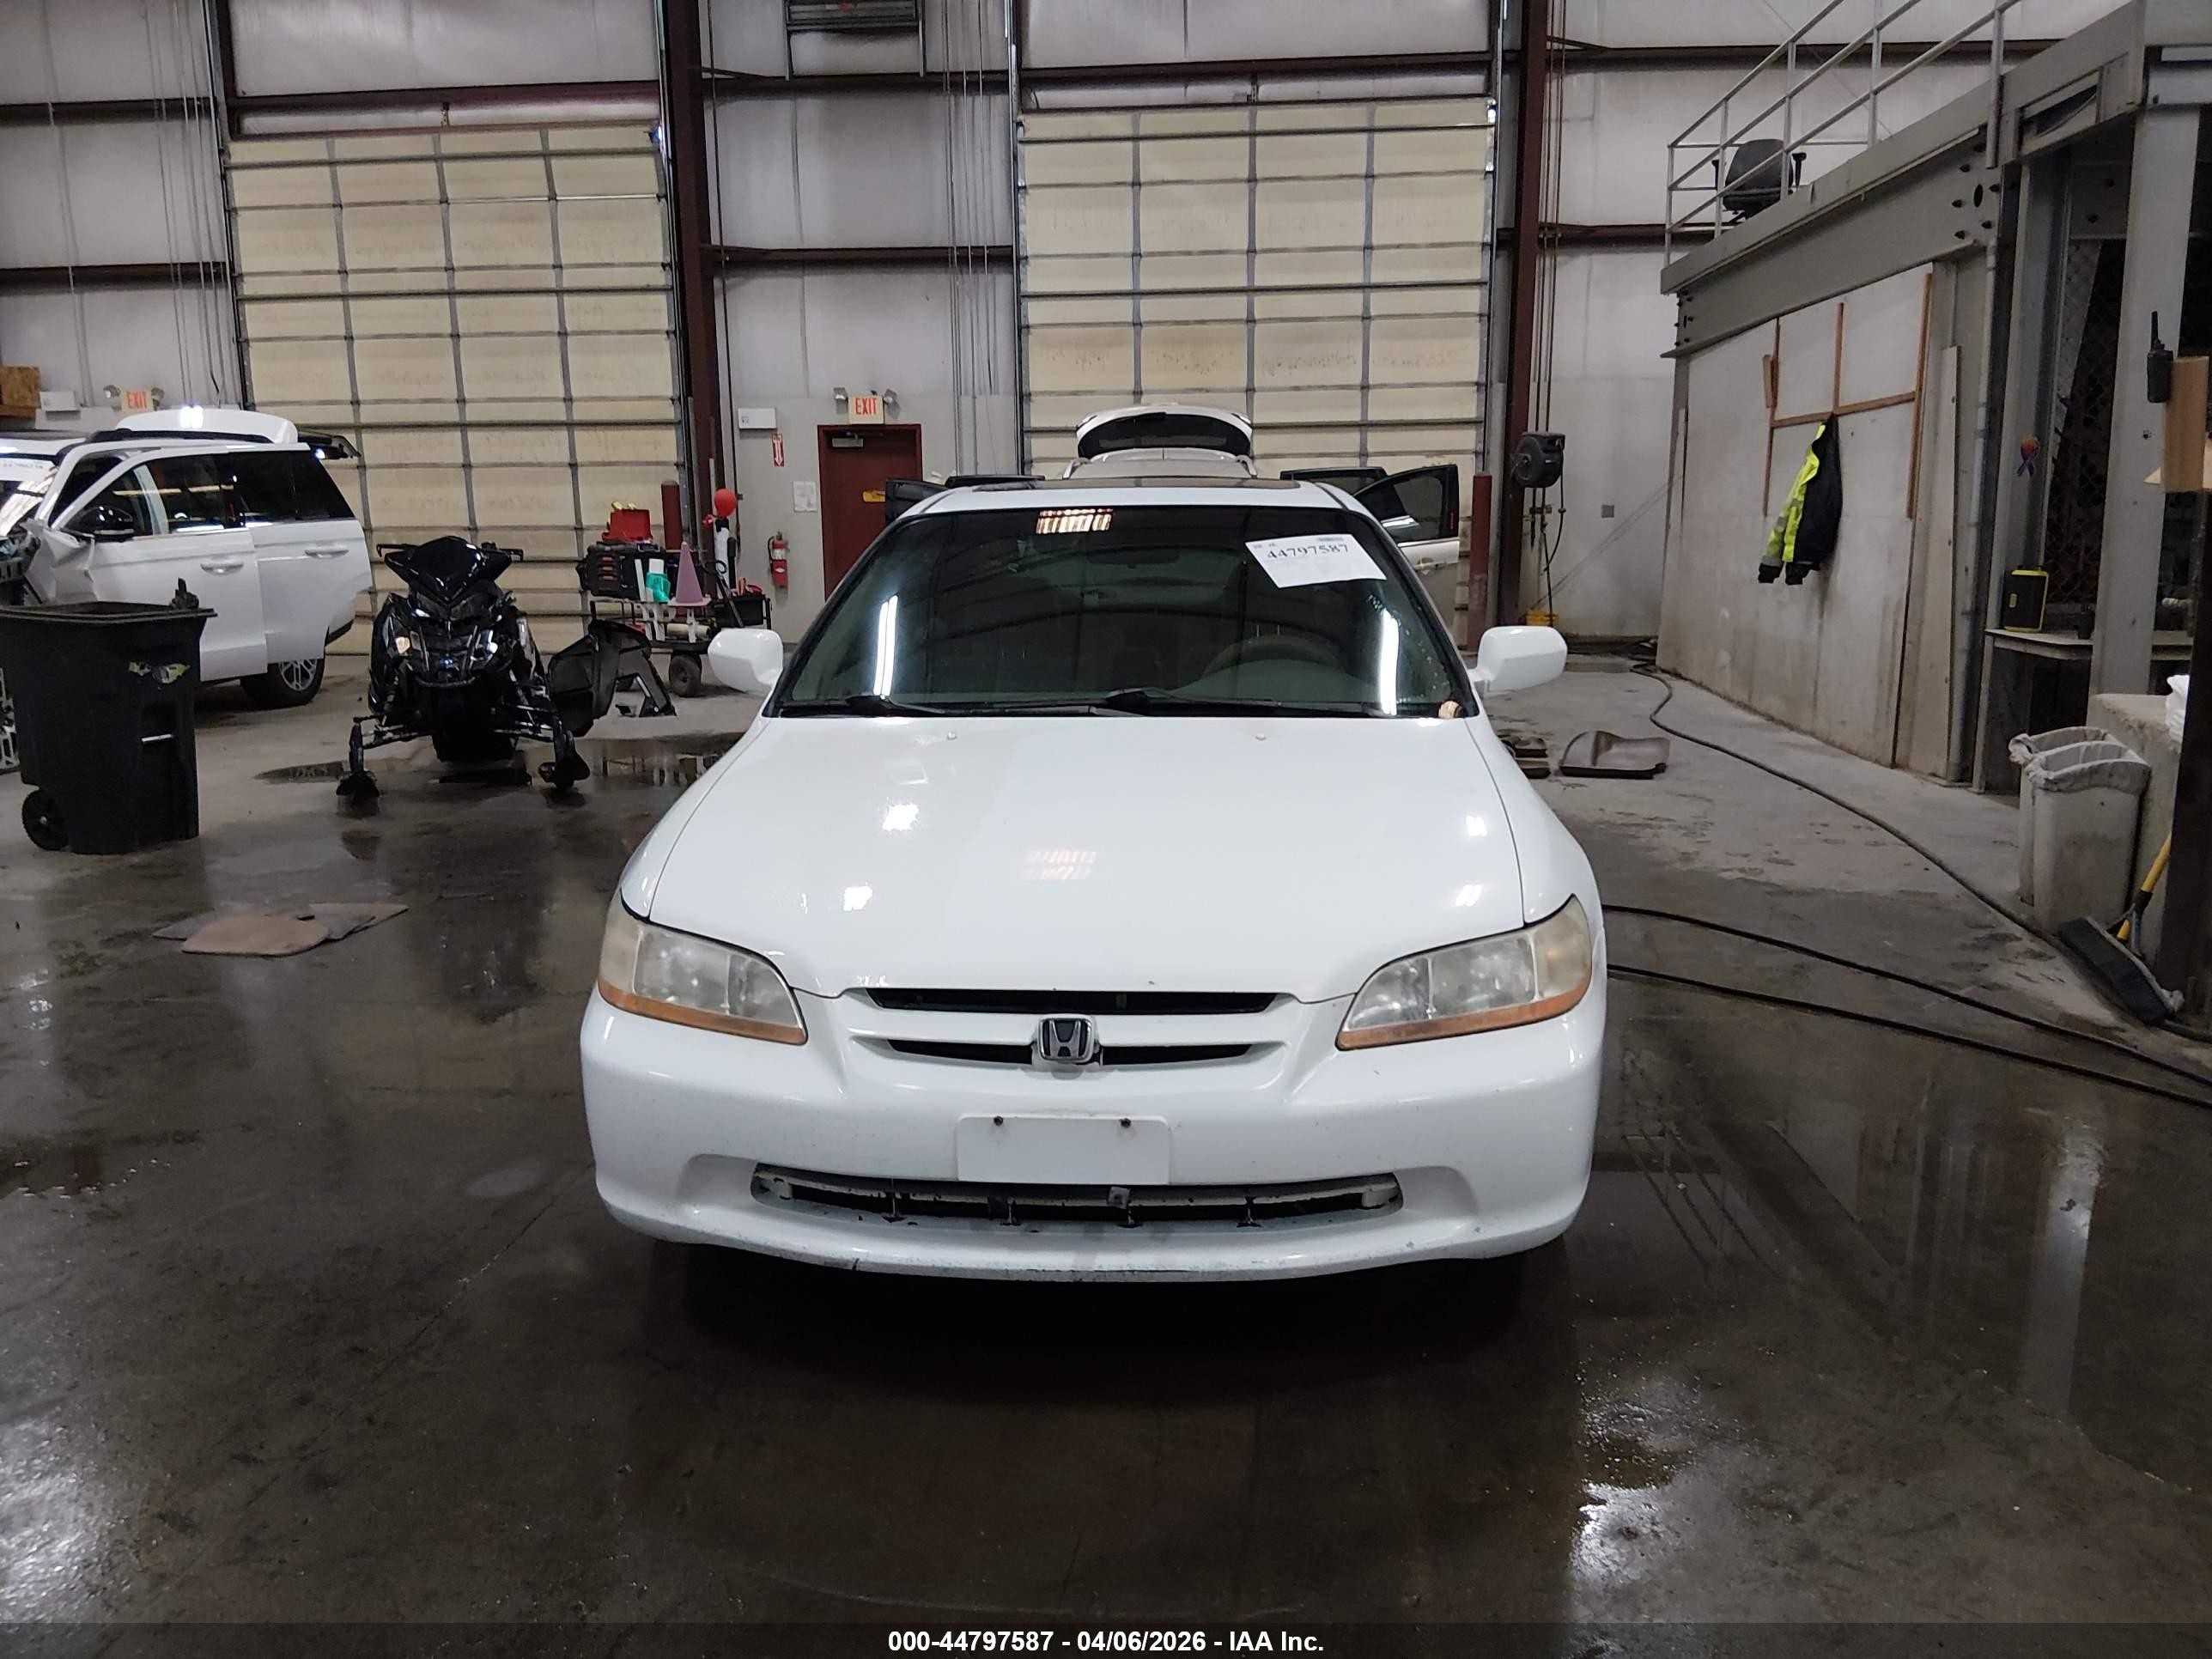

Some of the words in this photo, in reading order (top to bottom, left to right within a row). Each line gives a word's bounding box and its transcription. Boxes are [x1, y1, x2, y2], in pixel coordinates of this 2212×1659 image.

[126, 391, 147, 409] EXIT
[855, 398, 877, 415] EXIT
[1267, 544, 1349, 559] 44797587
